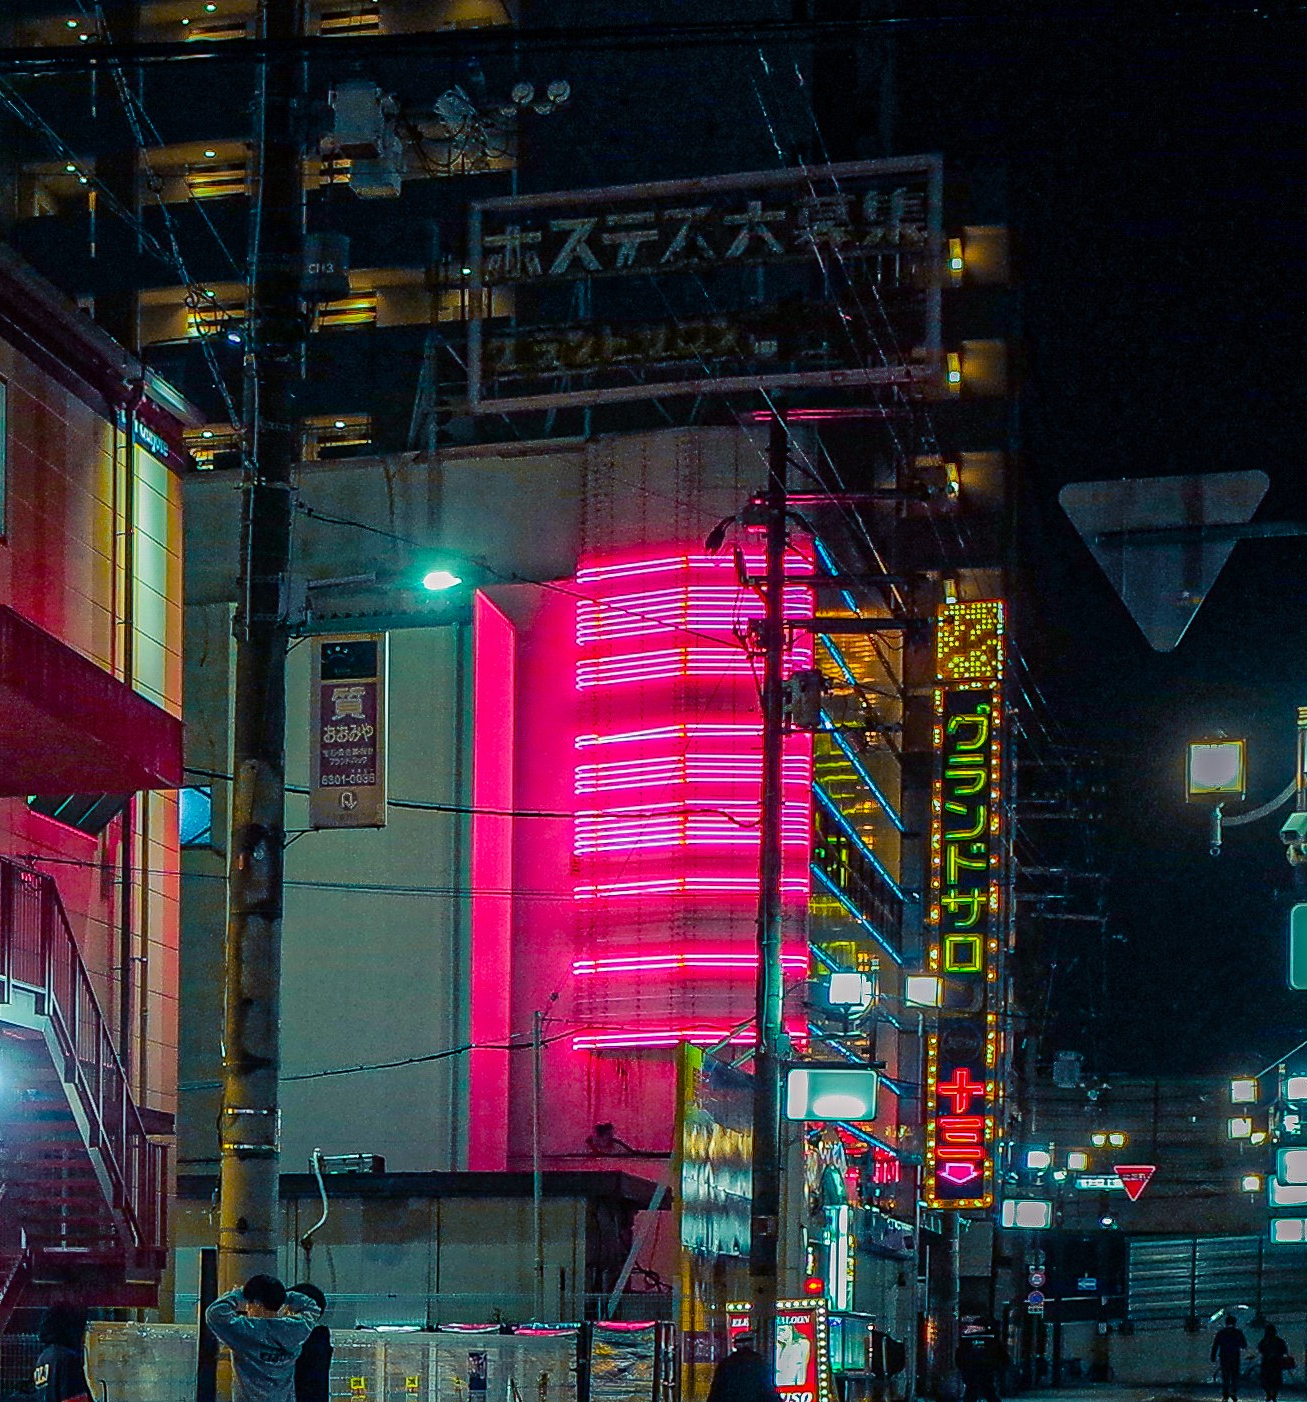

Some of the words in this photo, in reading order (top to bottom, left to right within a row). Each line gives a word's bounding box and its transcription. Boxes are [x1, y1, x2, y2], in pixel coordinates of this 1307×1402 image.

[483, 186, 927, 278] ホステス大募集
